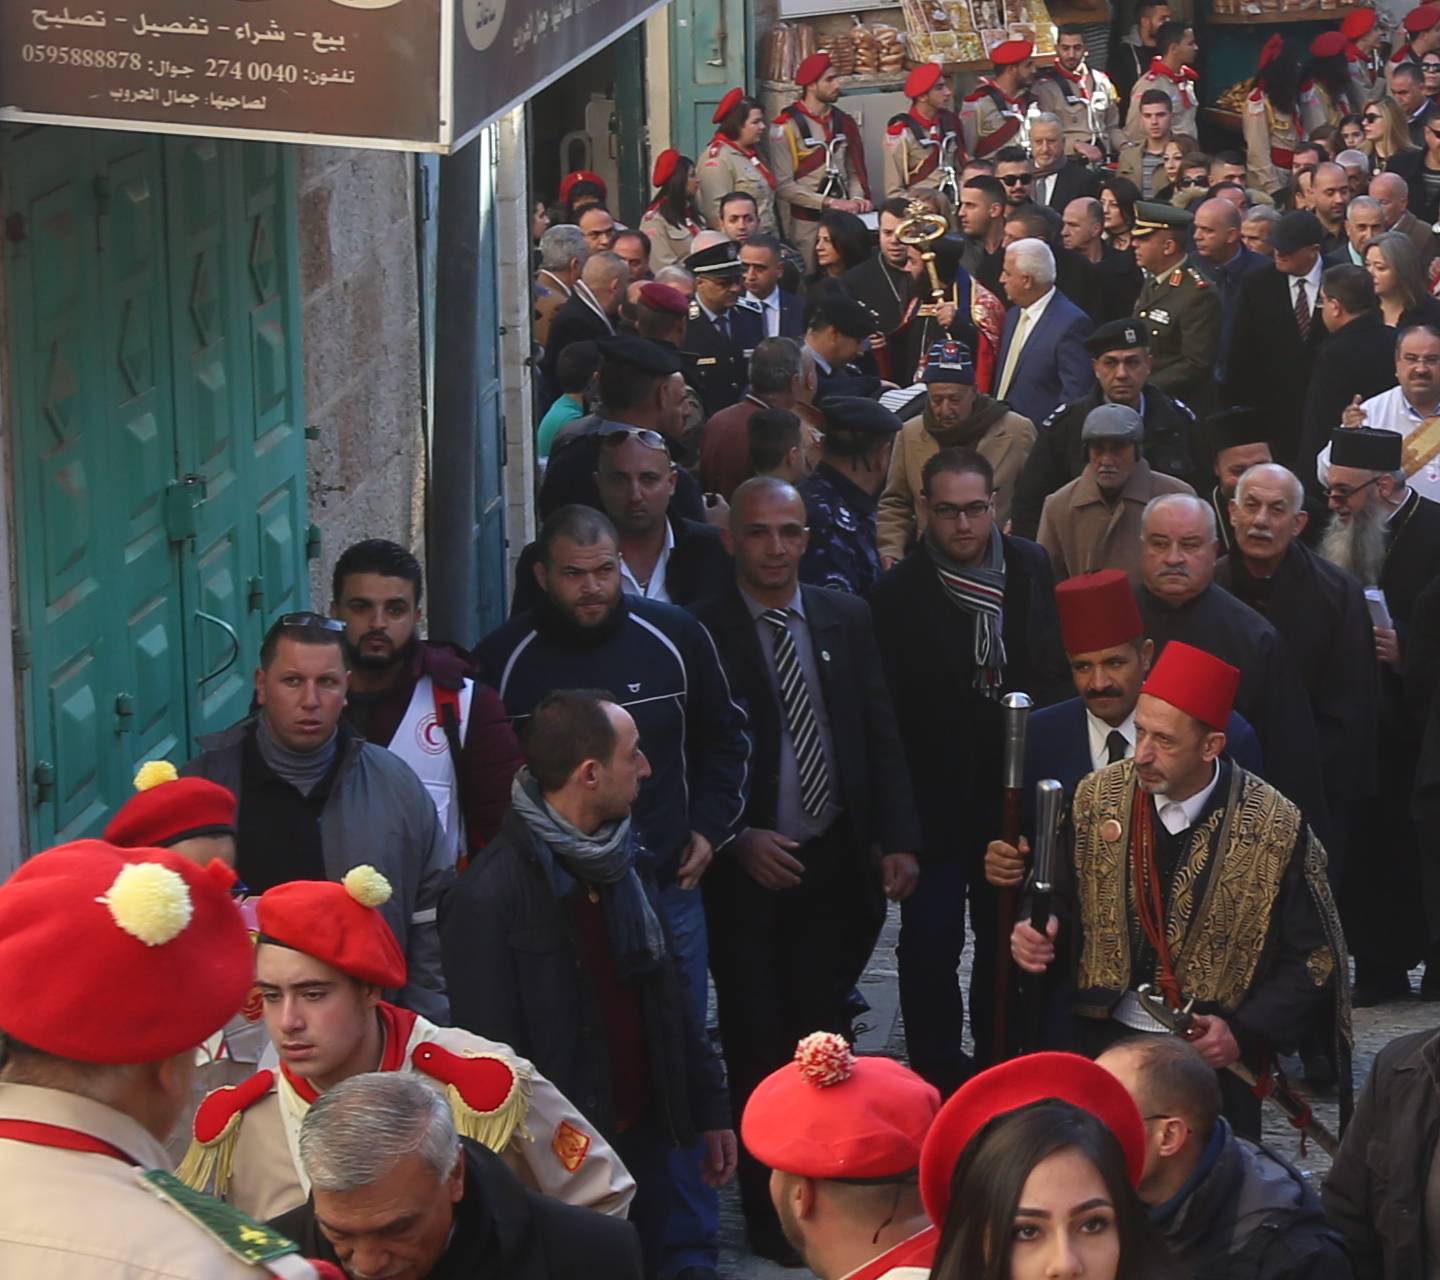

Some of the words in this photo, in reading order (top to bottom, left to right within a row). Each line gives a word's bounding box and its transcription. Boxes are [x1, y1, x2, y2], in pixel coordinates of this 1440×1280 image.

[31, 8, 106, 30] تصليح
[132, 13, 209, 37] تفصيل
[235, 20, 286, 45] شراء
[312, 30, 346, 52] بيع
[22, 44, 142, 71] 0595888878
[148, 58, 194, 80] جوال:
[204, 58, 243, 80] 274
[247, 61, 298, 84] 0040
[302, 67, 355, 86] تلفون:
[161, 90, 200, 108] جمال
